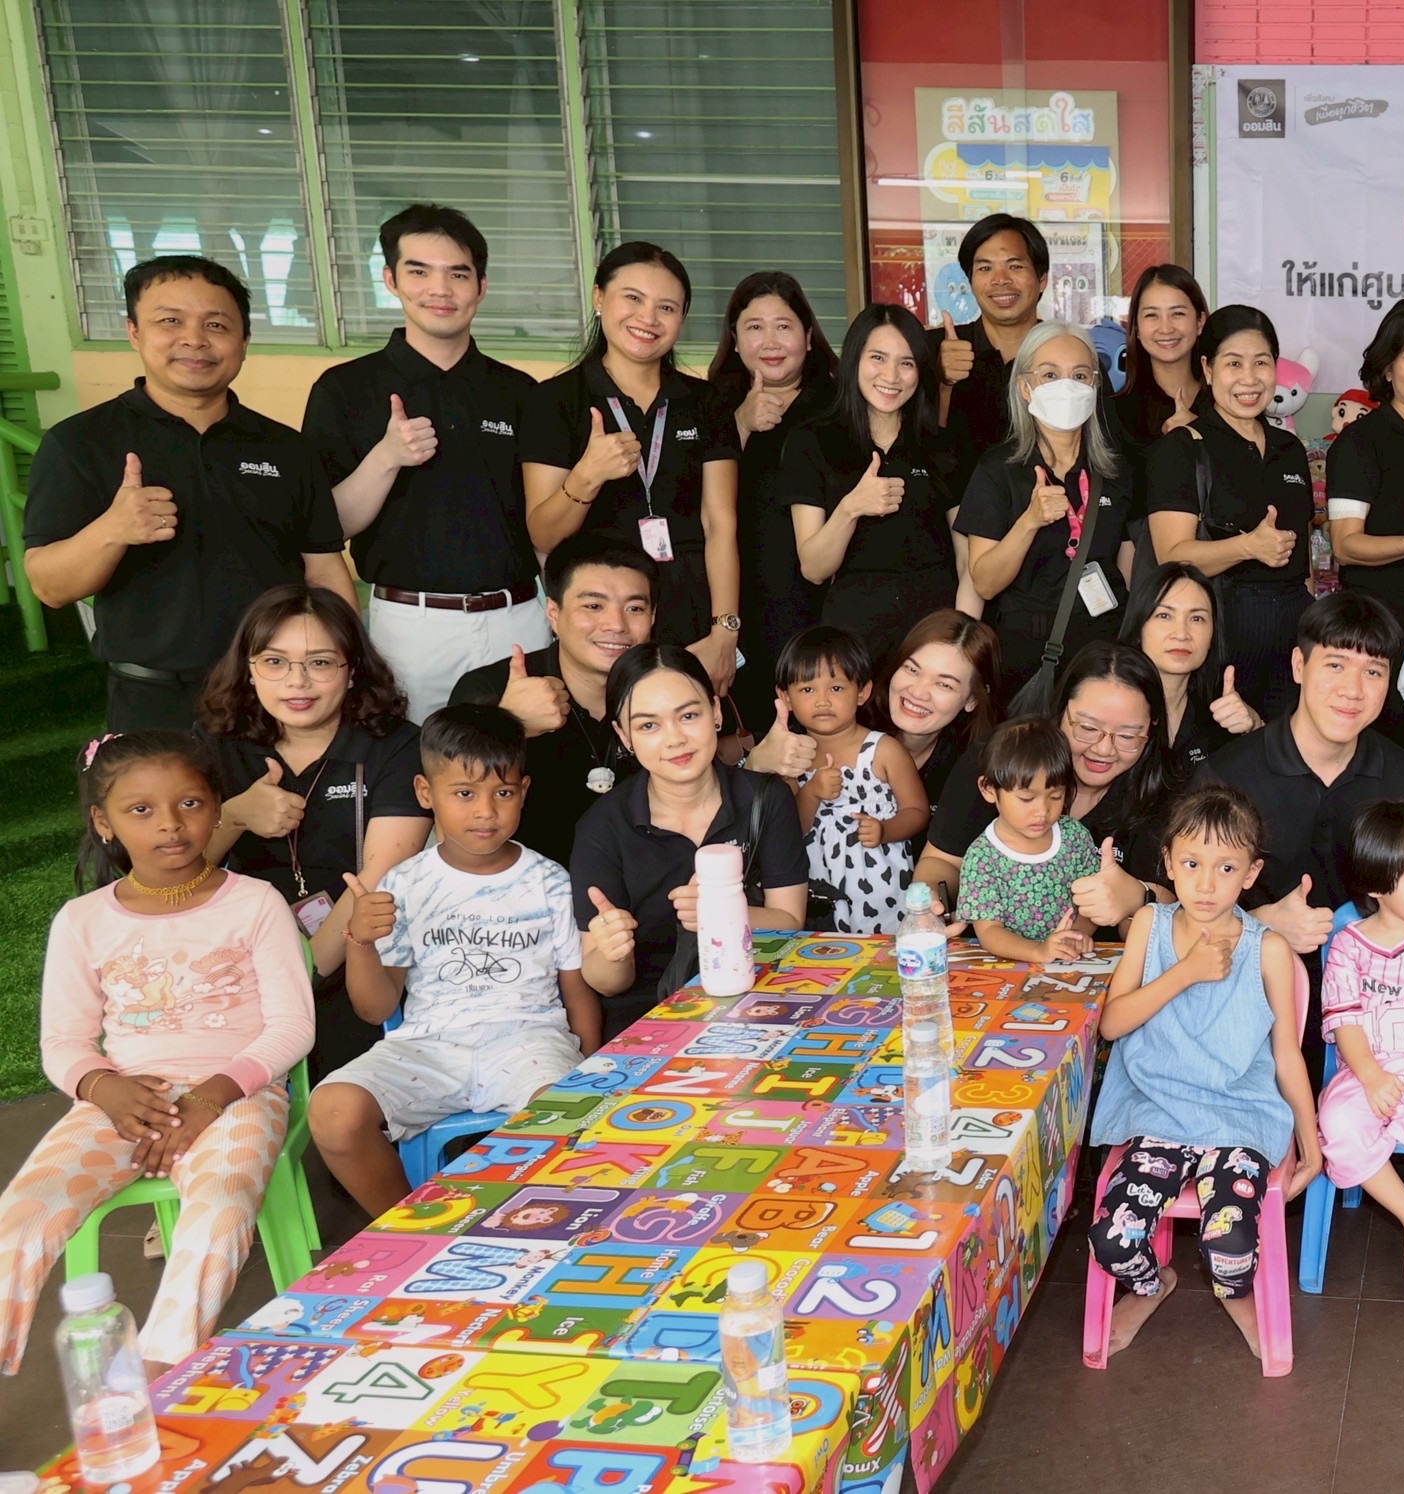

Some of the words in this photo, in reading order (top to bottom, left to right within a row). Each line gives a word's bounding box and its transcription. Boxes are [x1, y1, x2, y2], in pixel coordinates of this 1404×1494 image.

[947, 97, 1092, 134] สีสันสดใส
[1243, 119, 1281, 131] ออมสิน
[1362, 978, 1402, 996] New
[627, 1056, 662, 1082] Sheep
[801, 1066, 821, 1080] Ice
[576, 1097, 620, 1131] Tortoise
[783, 1119, 808, 1145] Jaguar
[618, 1164, 654, 1187] King
[680, 1168, 707, 1187] Fish
[850, 1170, 880, 1197] Apple
[974, 1167, 999, 1190] Zebra
[1236, 1182, 1253, 1195] MLP
[1127, 1183, 1153, 1197] Let's
[1139, 1192, 1163, 1206] Go!
[447, 1207, 488, 1234] Queen
[563, 1206, 605, 1232] Lion
[687, 1193, 728, 1227] Giraffe
[807, 1223, 839, 1250] Bear
[640, 1247, 679, 1281] Home
[356, 1273, 389, 1293] Rat
[499, 1264, 547, 1302] Monkey
[318, 1298, 372, 1333] Sheep
[551, 1314, 586, 1337] Ice
[154, 1344, 234, 1400] Elephant
[321, 1360, 435, 1404] 4
[424, 1387, 474, 1428] Yellow
[320, 1454, 374, 1494] Zebra
